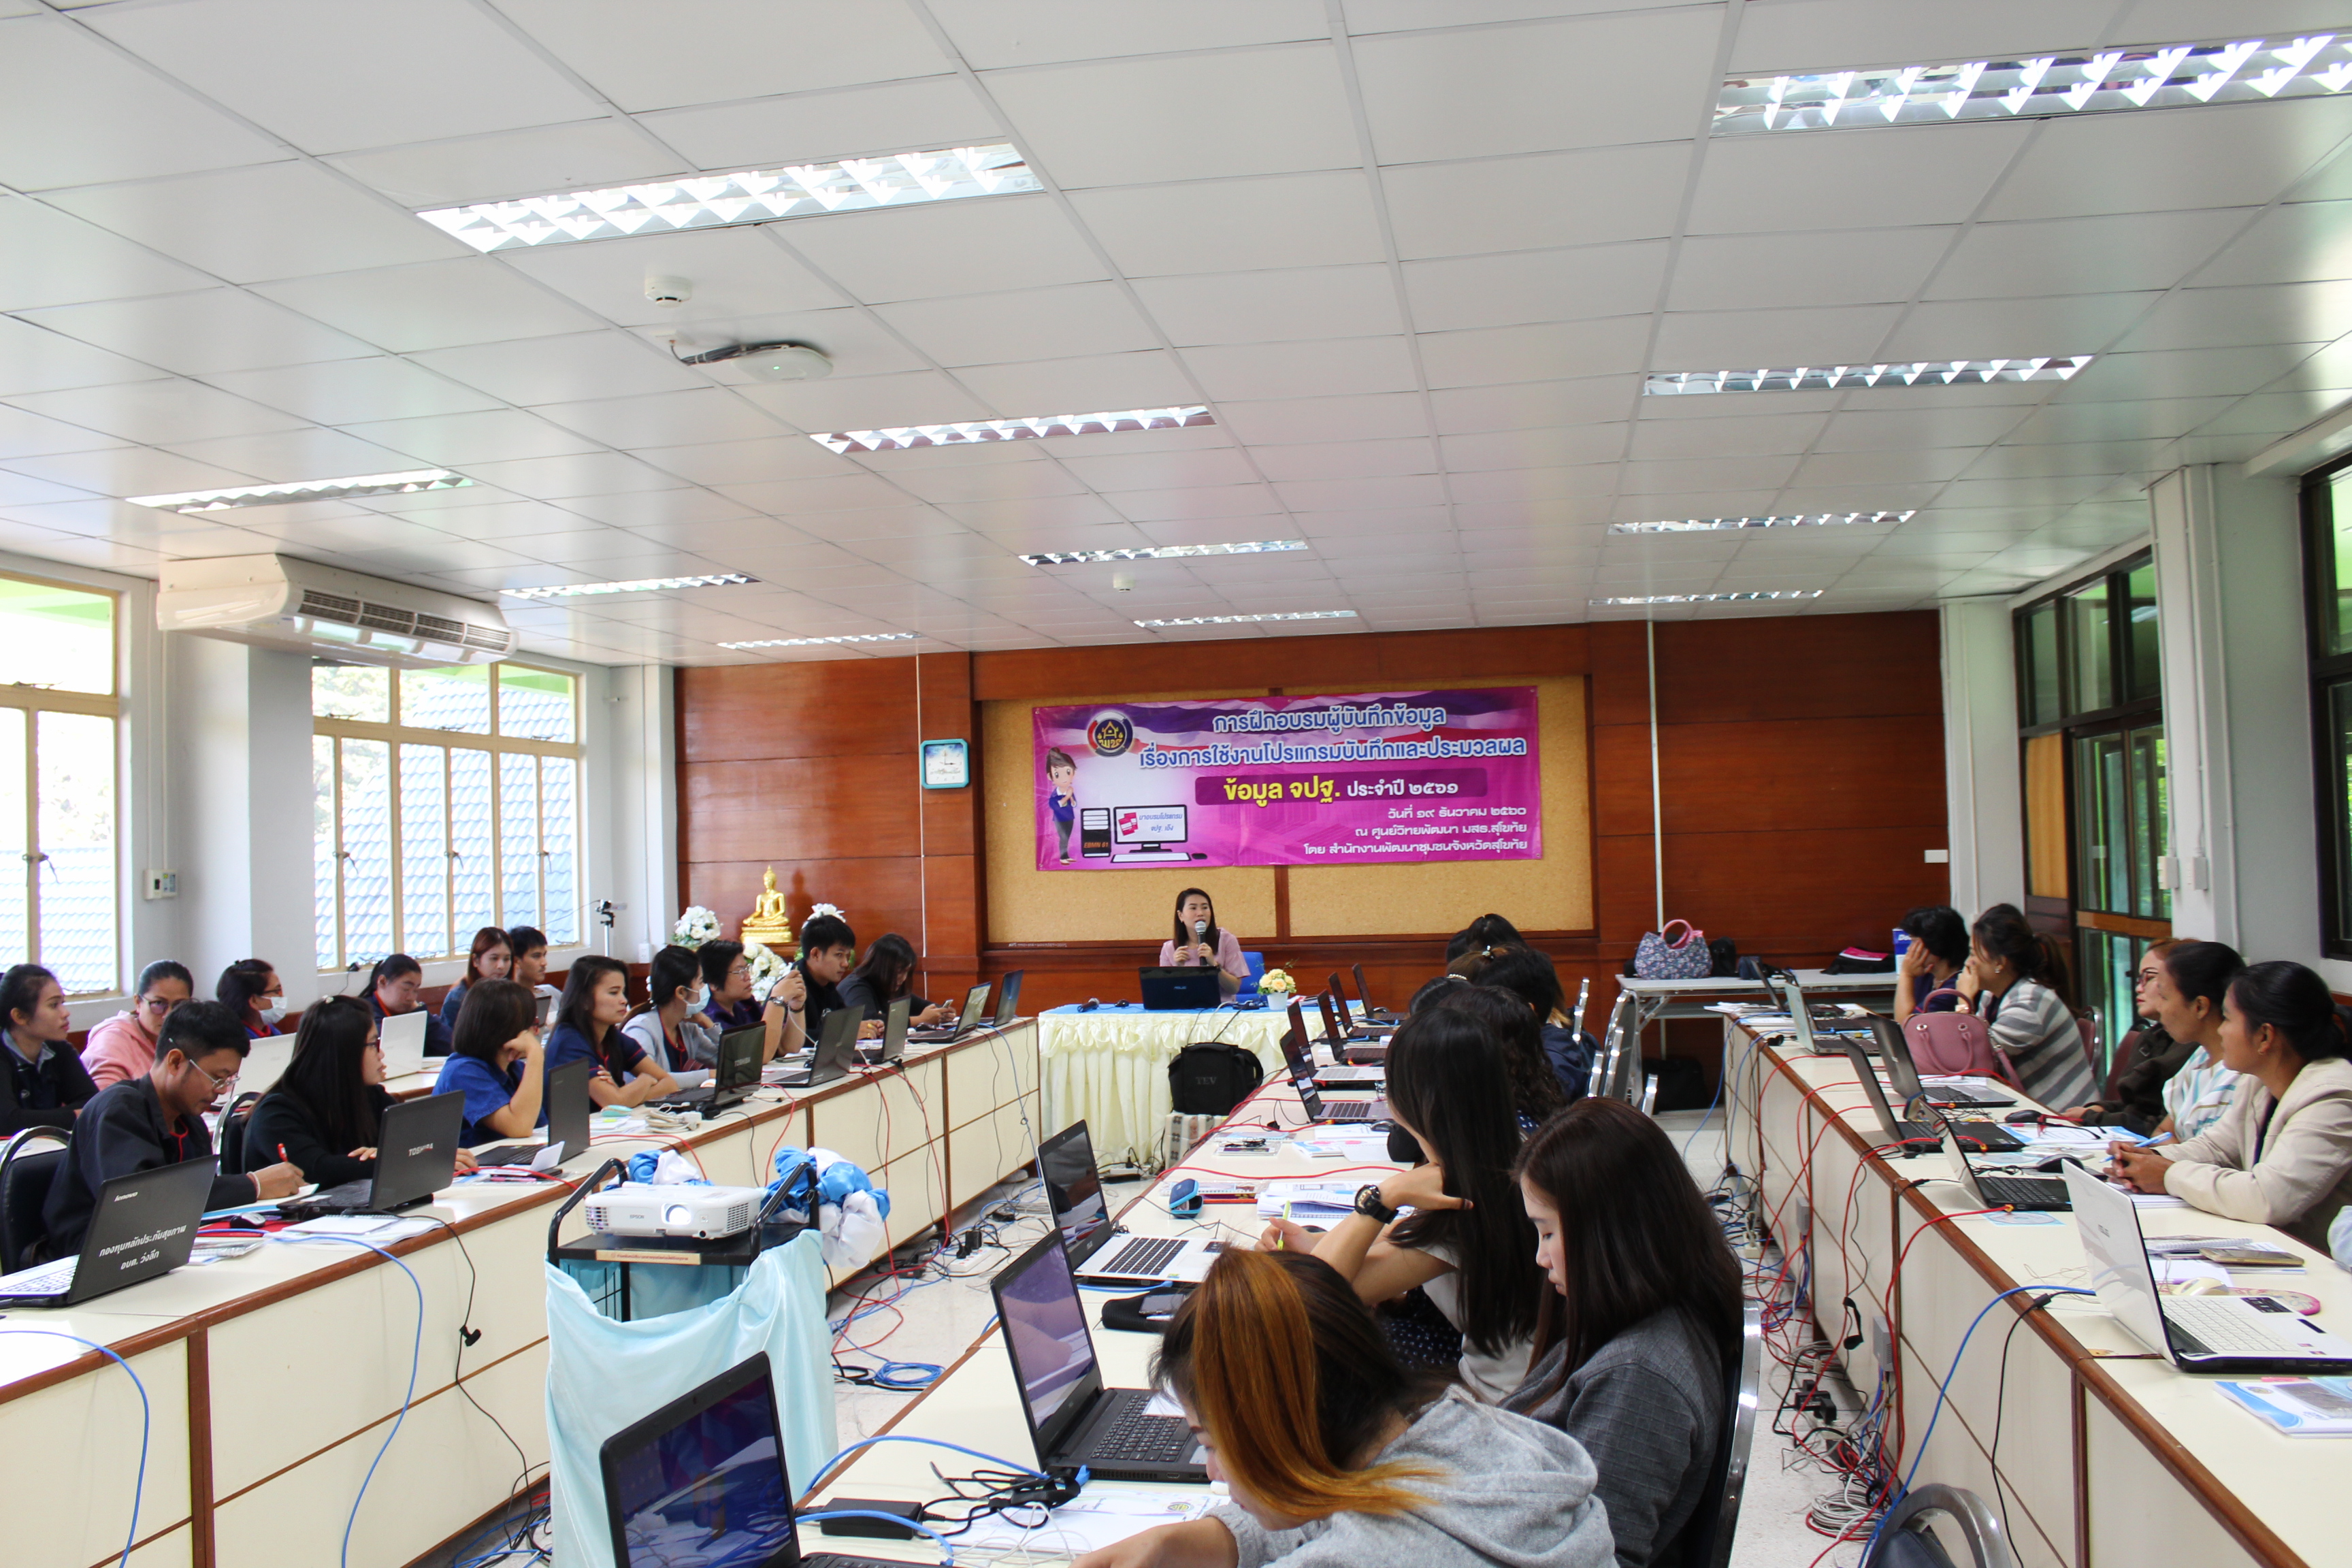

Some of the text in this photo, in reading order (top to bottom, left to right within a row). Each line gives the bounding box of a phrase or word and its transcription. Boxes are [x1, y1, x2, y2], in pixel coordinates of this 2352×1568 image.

[1213, 704, 1446, 734] การฝึกอบรมผู้บันทึกข้อมูล
[1139, 737, 1526, 767] เรื่องการใช้งานโปรแกรมบันทึกและประมวลผล
[1224, 775, 1459, 806] ข้อมูล จปฐ. ประจำปี ๒๕๖๑
[1388, 804, 1527, 819] วันที่ ๑๙ ธันวาคม ๒๕๖๐
[1354, 821, 1528, 840] ณ ศูนย์วิทยพัฒนา มสธ.สุโขทัย
[1303, 838, 1528, 855] โดย สำนักงานพัฒนาชุมชนจังหวัดสุโขทัย
[99, 1224, 187, 1258] กองทุนหลักประกันสุขภาพ
